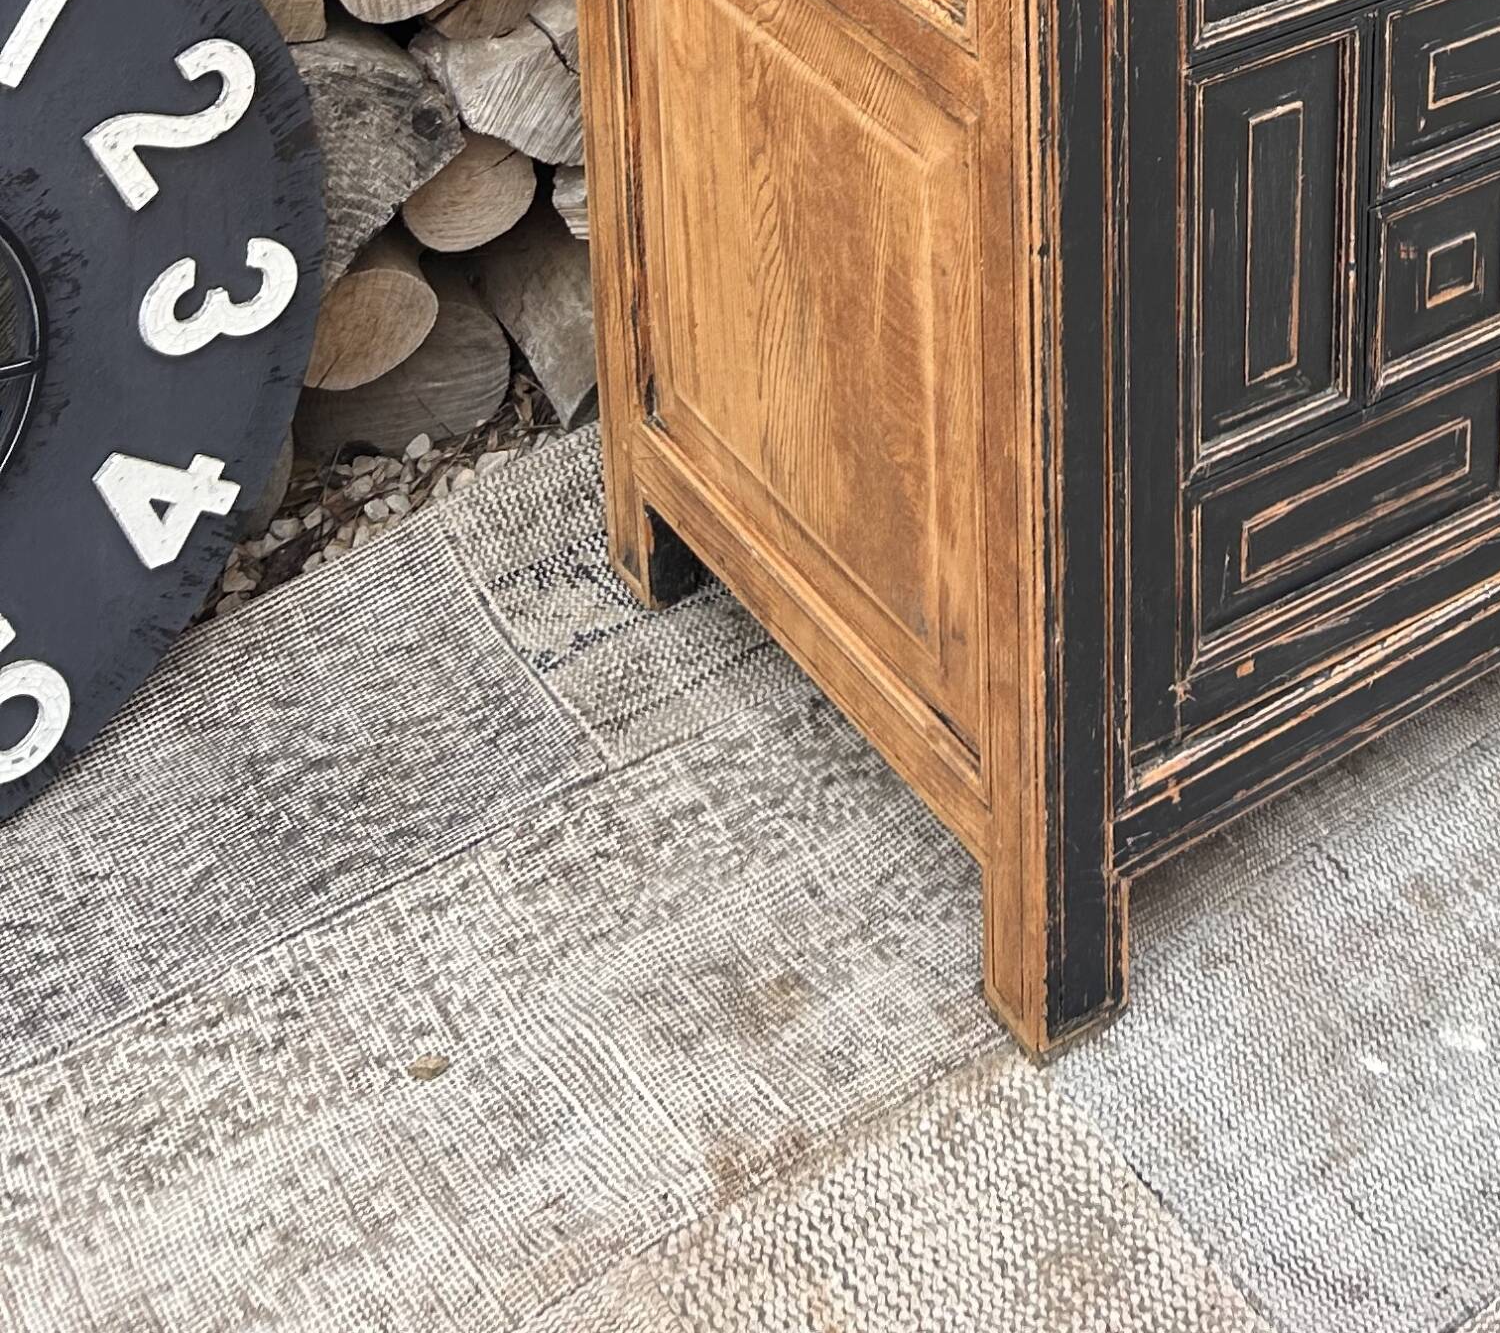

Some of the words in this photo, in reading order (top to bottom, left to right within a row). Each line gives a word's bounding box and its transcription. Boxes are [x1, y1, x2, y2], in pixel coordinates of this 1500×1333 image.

[83, 37, 256, 212] 2
[138, 236, 299, 357] 3
[92, 452, 241, 570] 4
